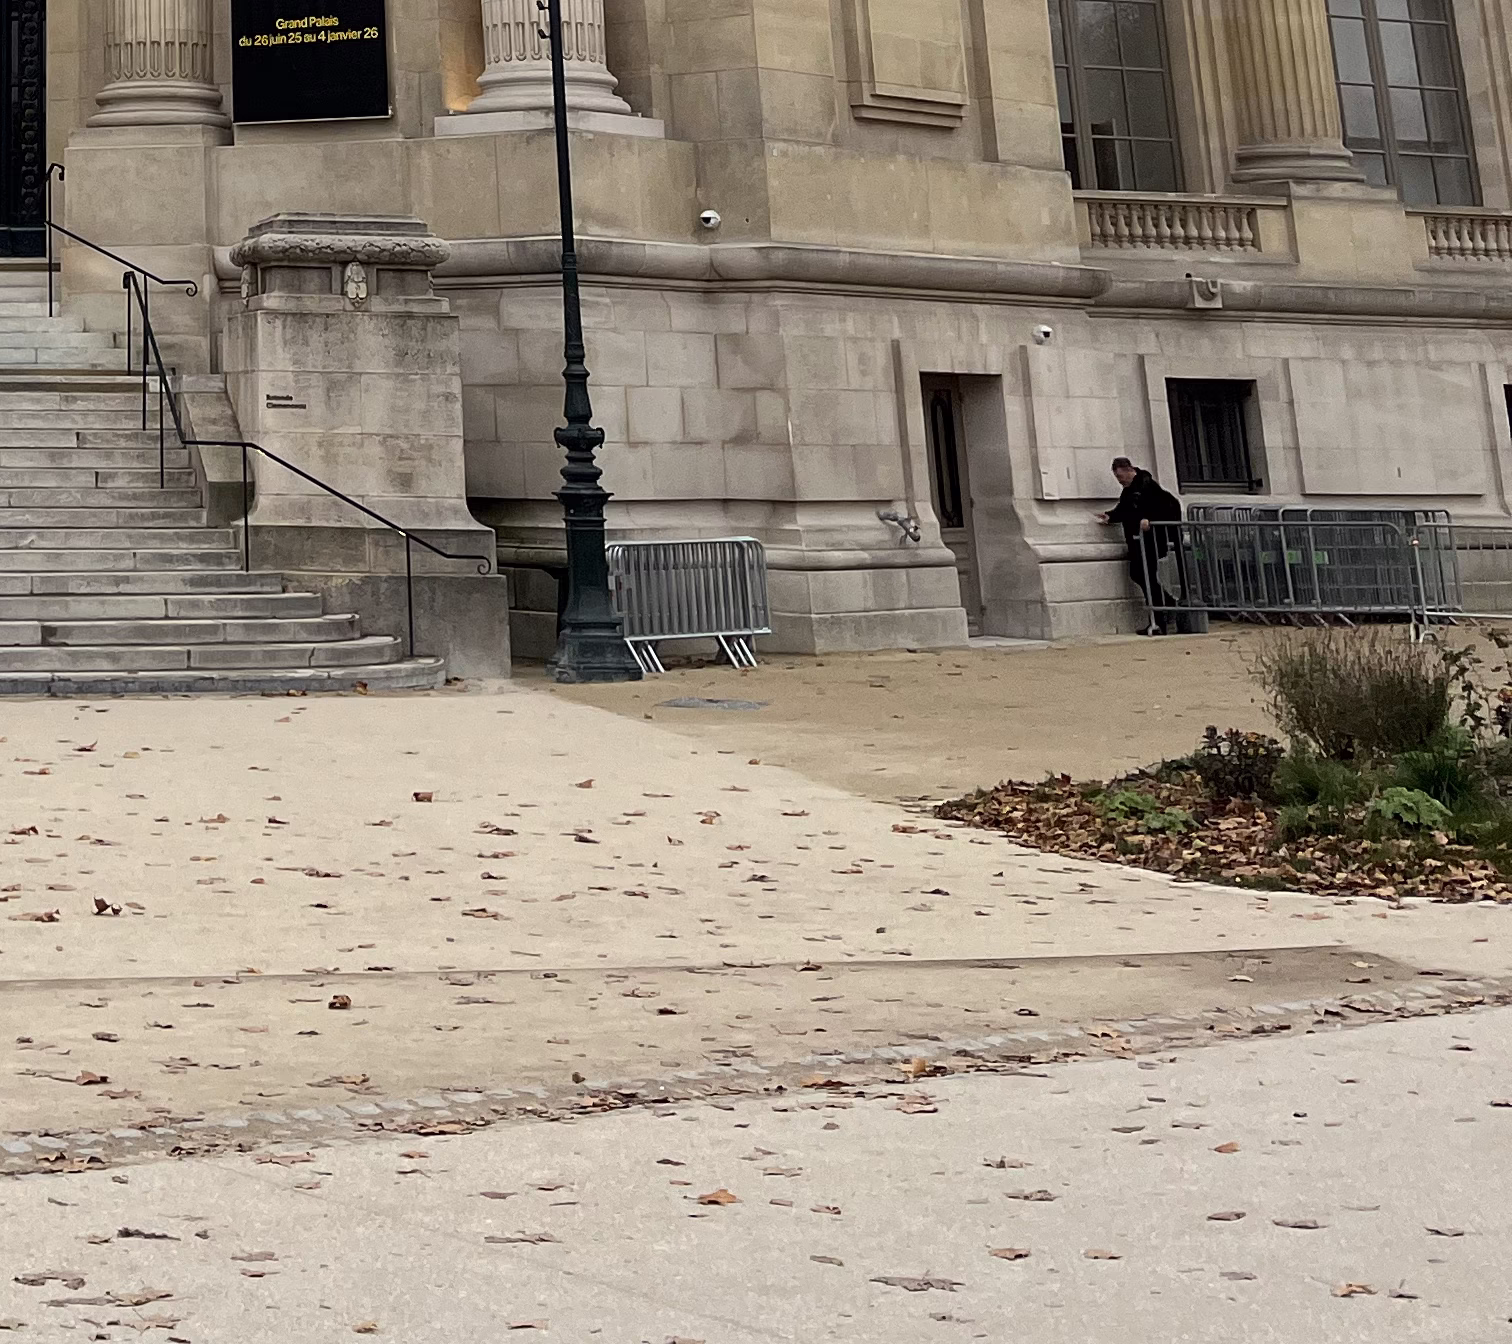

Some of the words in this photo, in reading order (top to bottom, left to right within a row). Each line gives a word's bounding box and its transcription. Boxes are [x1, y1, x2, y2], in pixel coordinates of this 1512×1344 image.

[275, 16, 308, 30] Grand
[309, 14, 339, 28] Palais
[238, 35, 252, 47] du
[253, 34, 269, 46] 26
[269, 33, 287, 47] juin
[287, 32, 303, 44] 25
[303, 33, 317, 43] au
[317, 30, 327, 42] 4
[327, 29, 363, 44] janvier
[363, 26, 379, 39] 26
